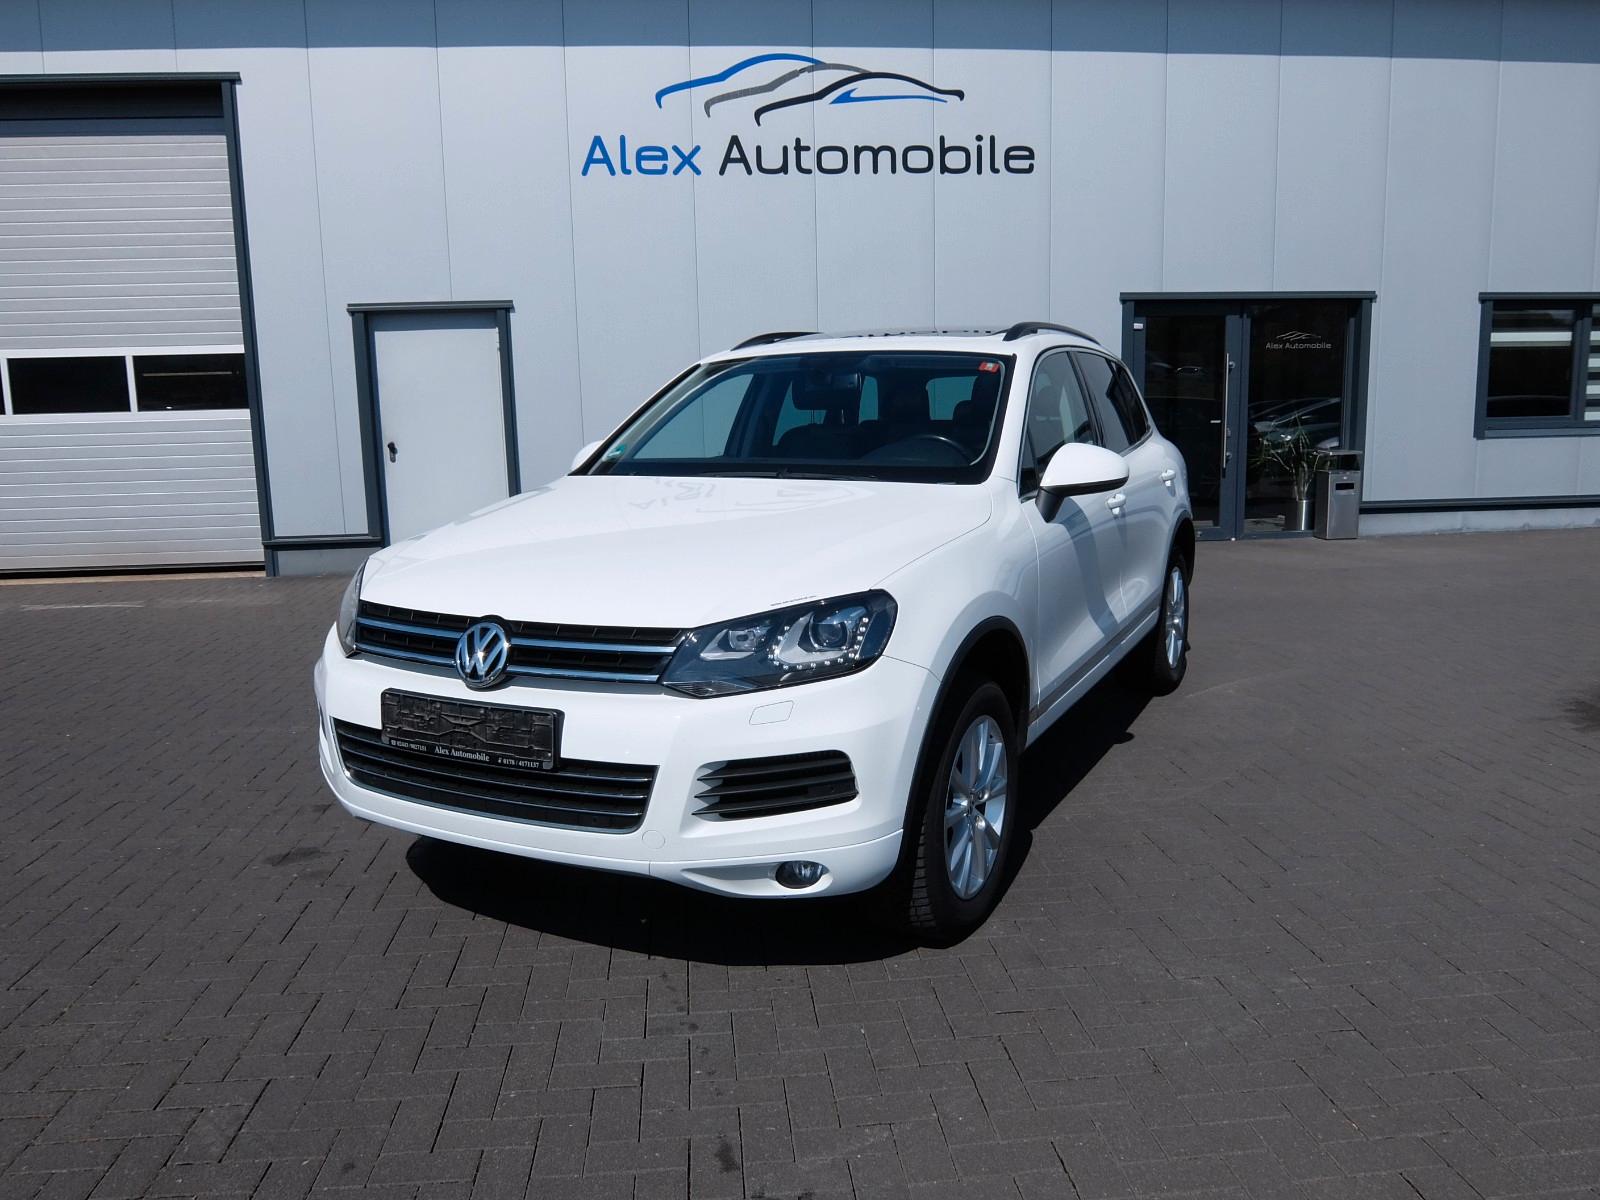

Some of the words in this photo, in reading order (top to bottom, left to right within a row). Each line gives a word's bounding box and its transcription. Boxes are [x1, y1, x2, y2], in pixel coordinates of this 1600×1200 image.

[582, 135, 702, 176] Alex
[719, 135, 1035, 175] Automobile
[434, 745, 450, 756] Alex
[450, 748, 490, 762] Automobile
